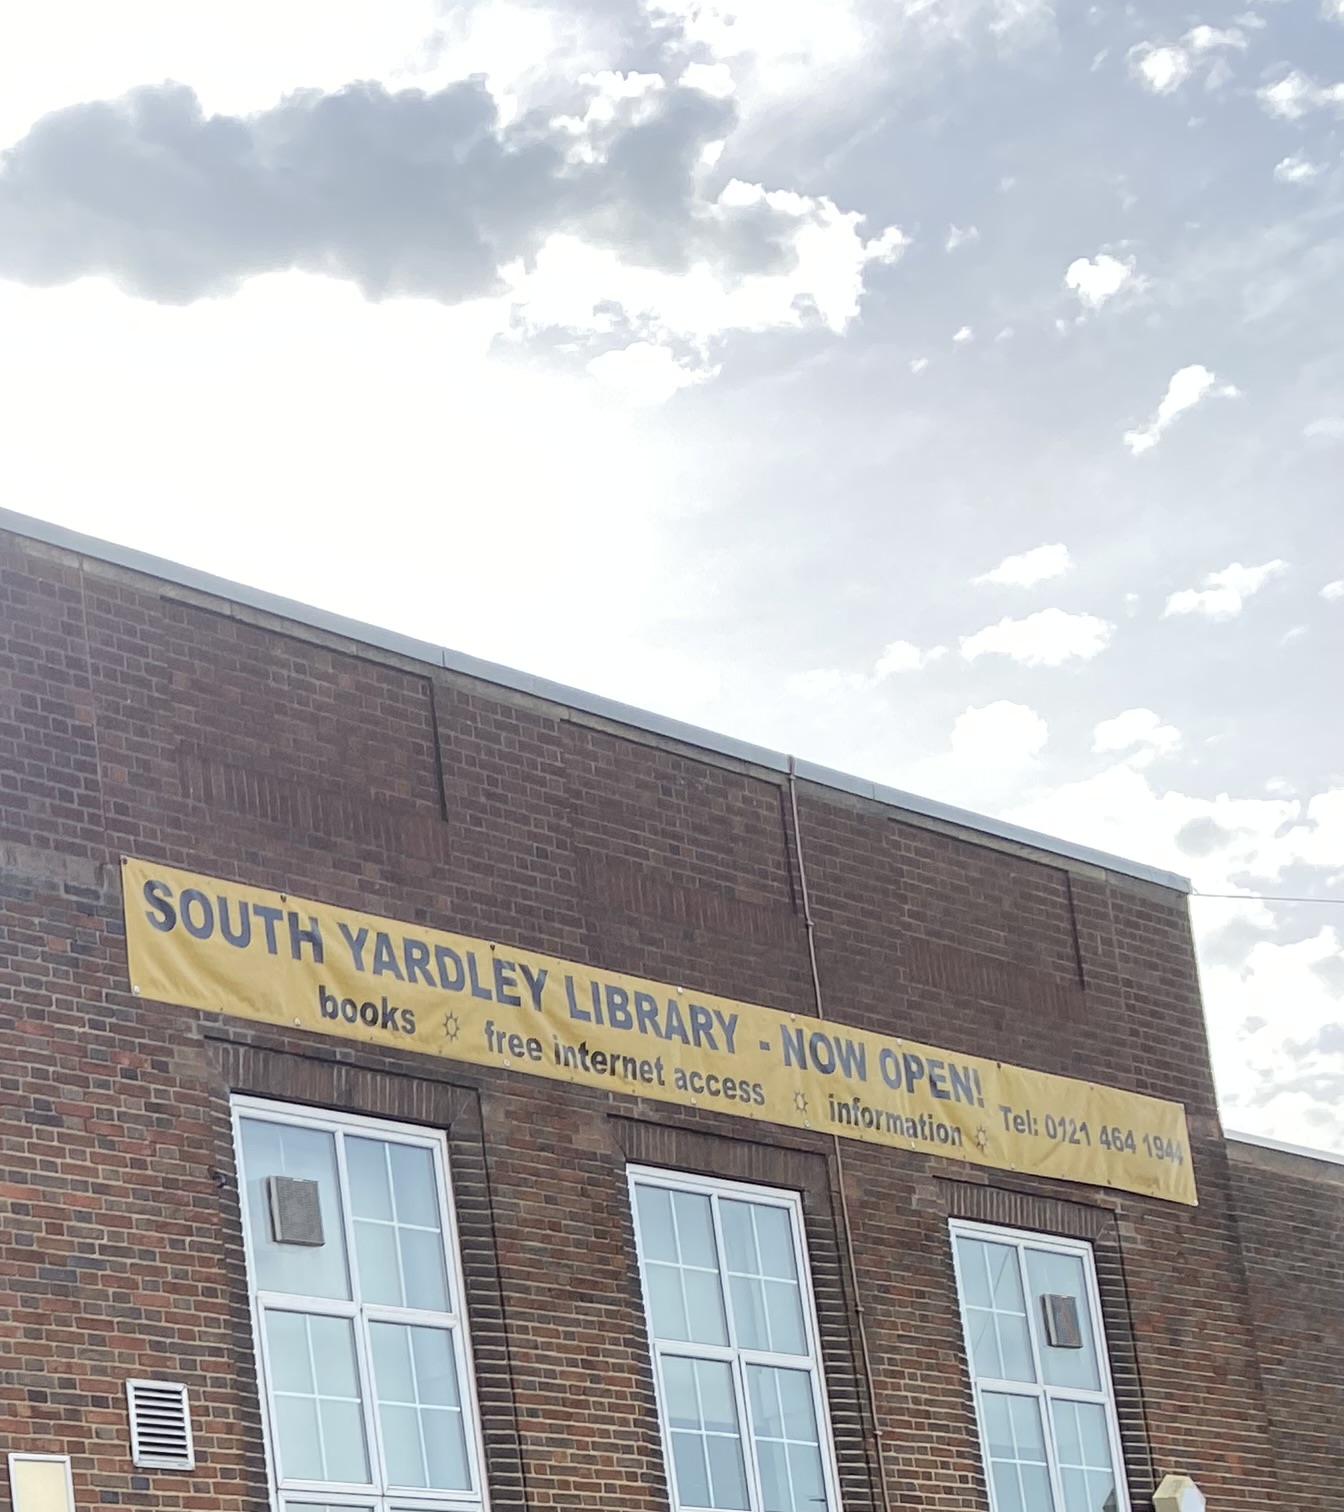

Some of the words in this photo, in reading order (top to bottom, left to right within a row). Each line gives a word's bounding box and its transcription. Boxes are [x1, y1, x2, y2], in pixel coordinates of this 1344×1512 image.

[142, 879, 325, 965] SOUTH
[336, 921, 549, 1013] YARDLEY
[564, 974, 739, 1055] LIBRARY
[779, 1023, 868, 1082] NOW
[878, 1047, 986, 1109] OPEN!
[317, 984, 417, 1035] books
[484, 1019, 543, 1061] free
[552, 1033, 666, 1087] internet
[673, 1066, 766, 1107] access
[828, 1093, 963, 1148] information
[998, 1103, 1039, 1137] Tel:
[1044, 1112, 1092, 1147] 0121
[1098, 1124, 1137, 1155] 464
[1142, 1132, 1184, 1166] 1944
